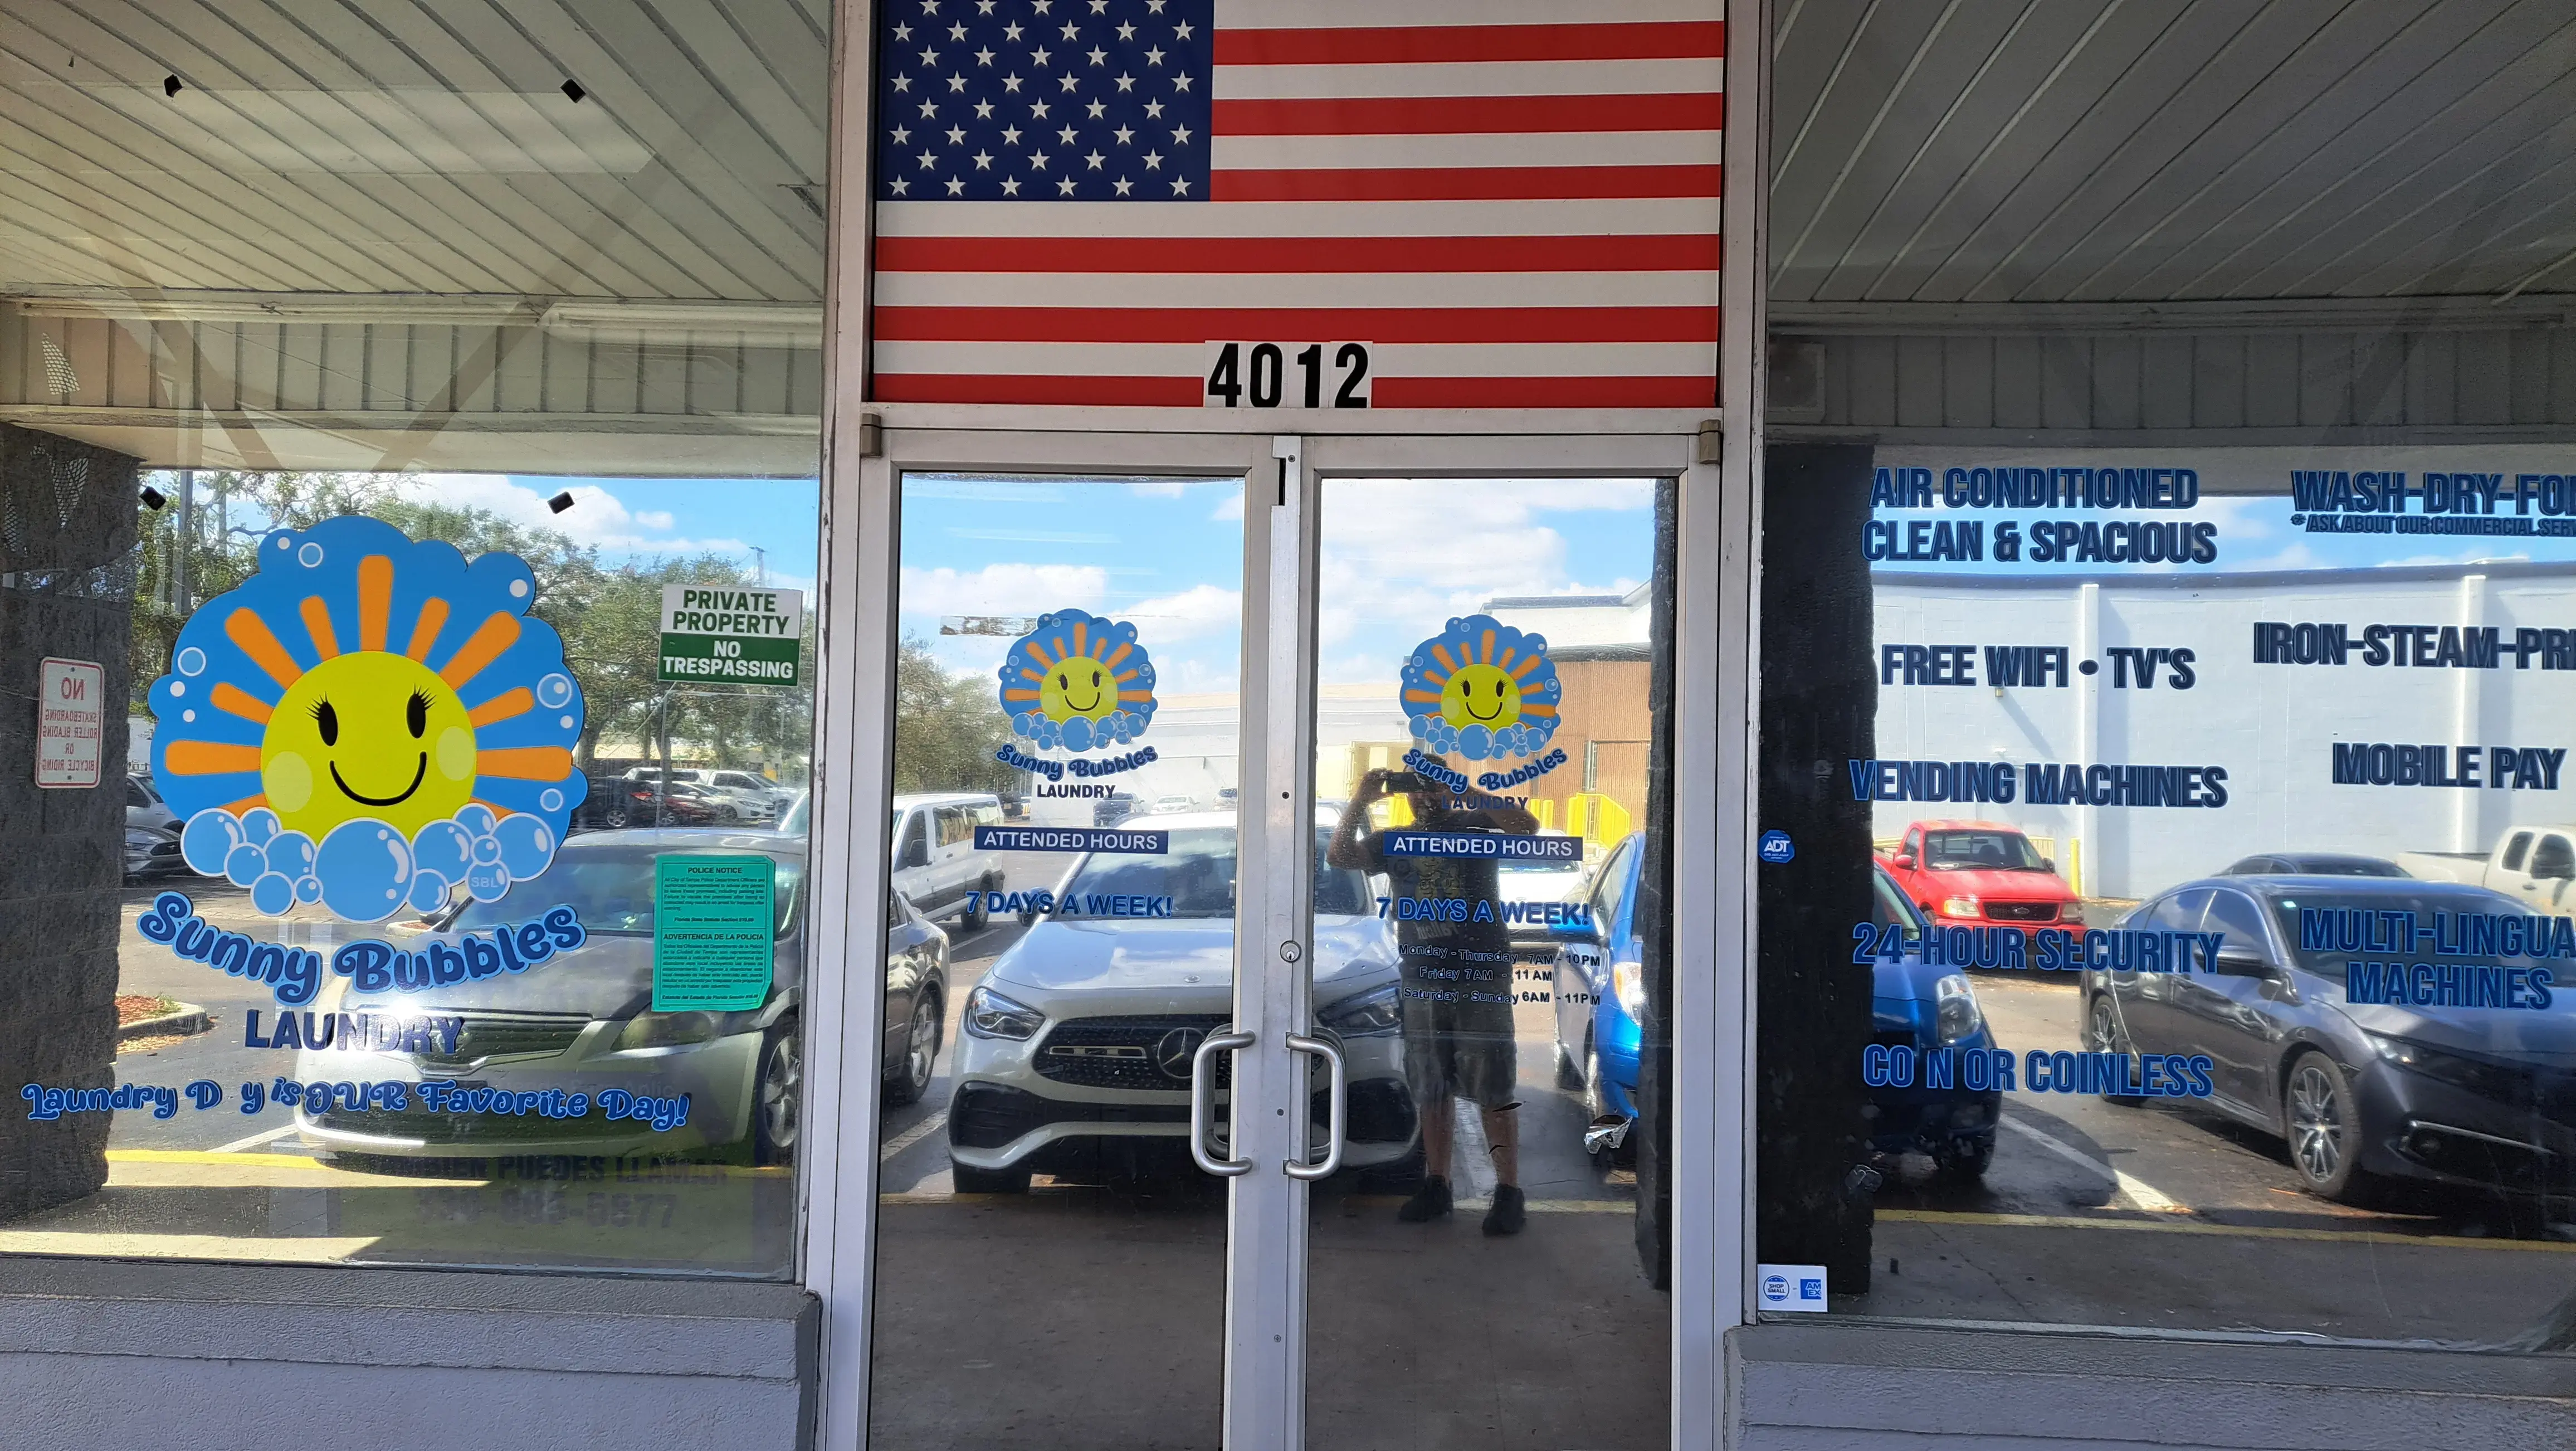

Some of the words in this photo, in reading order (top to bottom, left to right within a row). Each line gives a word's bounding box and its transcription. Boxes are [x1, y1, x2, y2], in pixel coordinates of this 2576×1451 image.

[1208, 343, 1368, 408] 4012
[1870, 468, 1934, 508] AIR
[1943, 468, 2199, 509] CONDITIONED
[2340, 515, 2394, 533] ABOUT
[2396, 516, 2431, 534] OUR
[2431, 517, 2539, 536] COMMERCIAL
[1861, 520, 1983, 562] CLEAN
[1994, 521, 2022, 562] &
[2030, 520, 2218, 564] SPACIOUS
[683, 590, 777, 612] PRIVATE
[672, 611, 790, 635] PROPERTY
[713, 640, 740, 658] NO
[663, 656, 793, 679] TRESPASSING
[1881, 644, 1977, 686] FREE
[1984, 645, 2069, 688] WIFI
[2106, 646, 2196, 690] TV'S
[996, 743, 1063, 781] Sunny
[1068, 746, 1159, 779] Bubbles
[1402, 748, 1469, 794] Sunny
[1477, 747, 1568, 791] Bubbles
[2333, 743, 2482, 788] MOBILE
[2491, 746, 2568, 790] PAY
[1037, 784, 1116, 799] LAUNDRY
[1848, 756, 2016, 804] VENDING
[2025, 763, 2229, 809] MACHINES
[1441, 796, 1528, 811] LAUNDRY
[984, 830, 1085, 848] ATTENDED
[1090, 834, 1158, 851] HOURS
[1393, 836, 1496, 854] ATTENDED
[1502, 840, 1573, 856] HOURS
[1763, 840, 1790, 853] ADT
[471, 877, 505, 888] SBL
[964, 891, 981, 914] 7
[987, 892, 1055, 916] DAYS
[1061, 893, 1081, 916] A
[1086, 895, 1174, 918] WEEK!
[1376, 897, 1391, 920] 7
[1398, 898, 1468, 922] DAYS
[1472, 899, 1495, 923] A
[1500, 901, 1591, 926] WEEK!
[136, 891, 323, 1007] Sunny
[331, 904, 586, 994] Bubbles
[1399, 944, 1448, 959] Monday
[1458, 949, 1518, 963] Thursday
[1528, 954, 1553, 965] 7AM
[1567, 954, 1601, 966] 10PM
[1852, 922, 2028, 970] 24-HOUR
[2035, 928, 2226, 974] SECURITY
[1419, 966, 1460, 981] Friday
[1464, 969, 1494, 981] 7AM
[2346, 961, 2553, 1010] MACHINES
[1404, 987, 1459, 1001] Saturday
[1471, 990, 1519, 1005] Sunday
[1522, 992, 1550, 1003] 6AM
[1564, 992, 1601, 1005] 11PM
[245, 1009, 466, 1054] LAUNDRY
[1964, 1048, 2017, 1093] OR
[2026, 1049, 2214, 1098] COINLESS
[21, 1082, 177, 1119] Laundry
[271, 1077, 303, 1107] is
[304, 1079, 409, 1114] OUR
[416, 1079, 588, 1118] Favorite
[596, 1088, 692, 1132] Day!
